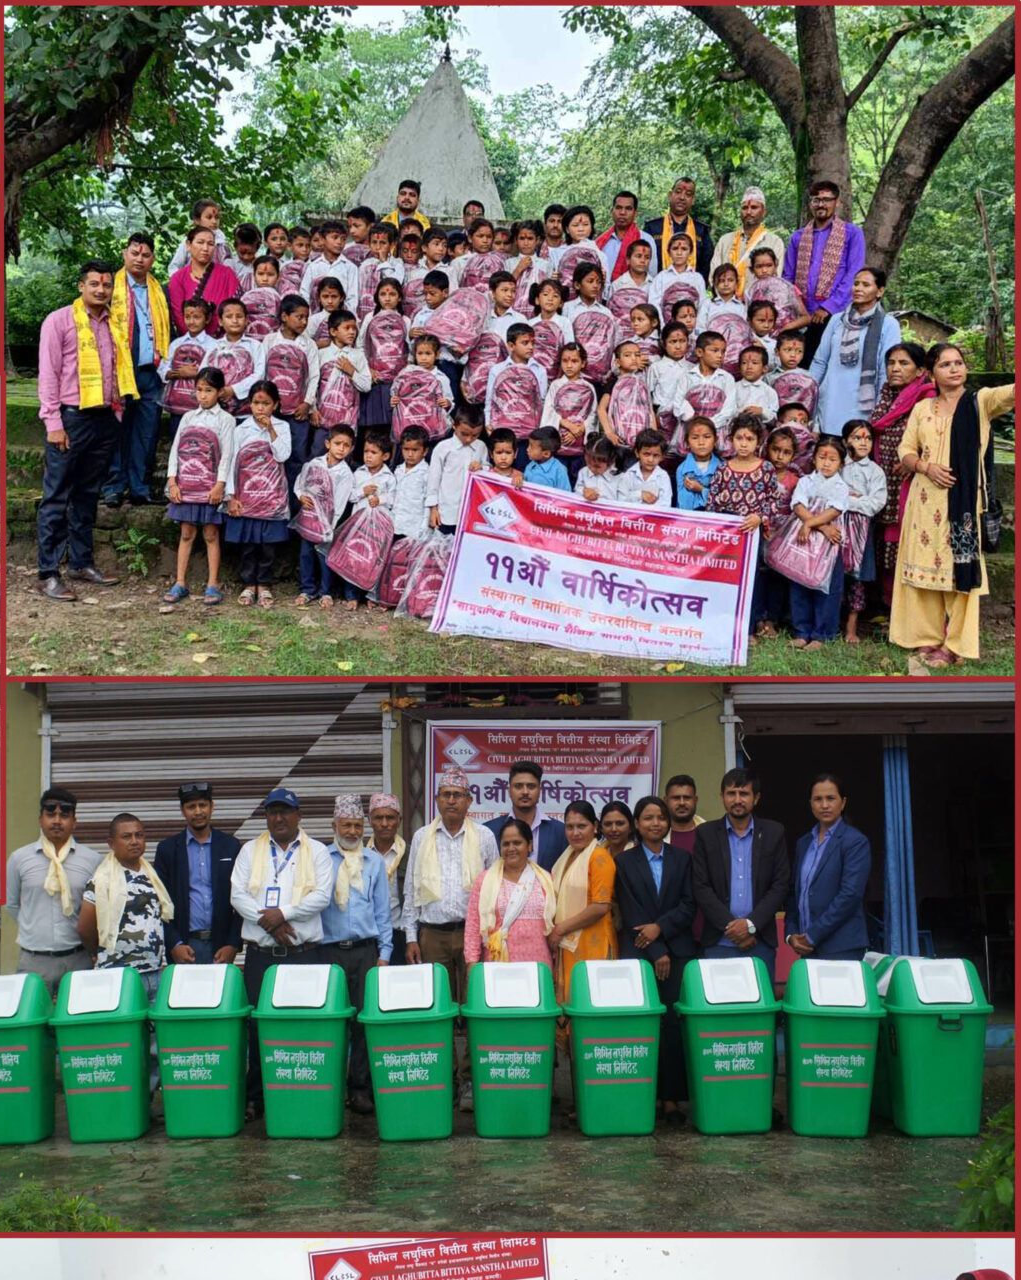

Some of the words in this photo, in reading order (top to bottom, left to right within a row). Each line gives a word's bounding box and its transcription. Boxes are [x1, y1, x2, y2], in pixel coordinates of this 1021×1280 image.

[533, 499, 568, 518] सिभिल
[621, 512, 655, 532] वित्तीय
[561, 569, 709, 619] वार्षिकोत्सव
[488, 733, 516, 744] सिभिल
[521, 734, 553, 747] लघुवित्त
[557, 733, 584, 744] वित्तीय
[588, 734, 610, 744] संस्था
[487, 755, 508, 763] CIVIL
[368, 1251, 398, 1265] सिभिल
[402, 1246, 435, 1262] लघुवित्त
[439, 1242, 468, 1256] वित्तीय
[473, 1240, 496, 1251] संस्था
[440, 1267, 470, 1277] BITTIYA
[470, 1262, 505, 1274] SANSTHA
[505, 1258, 539, 1270] LIMITED
